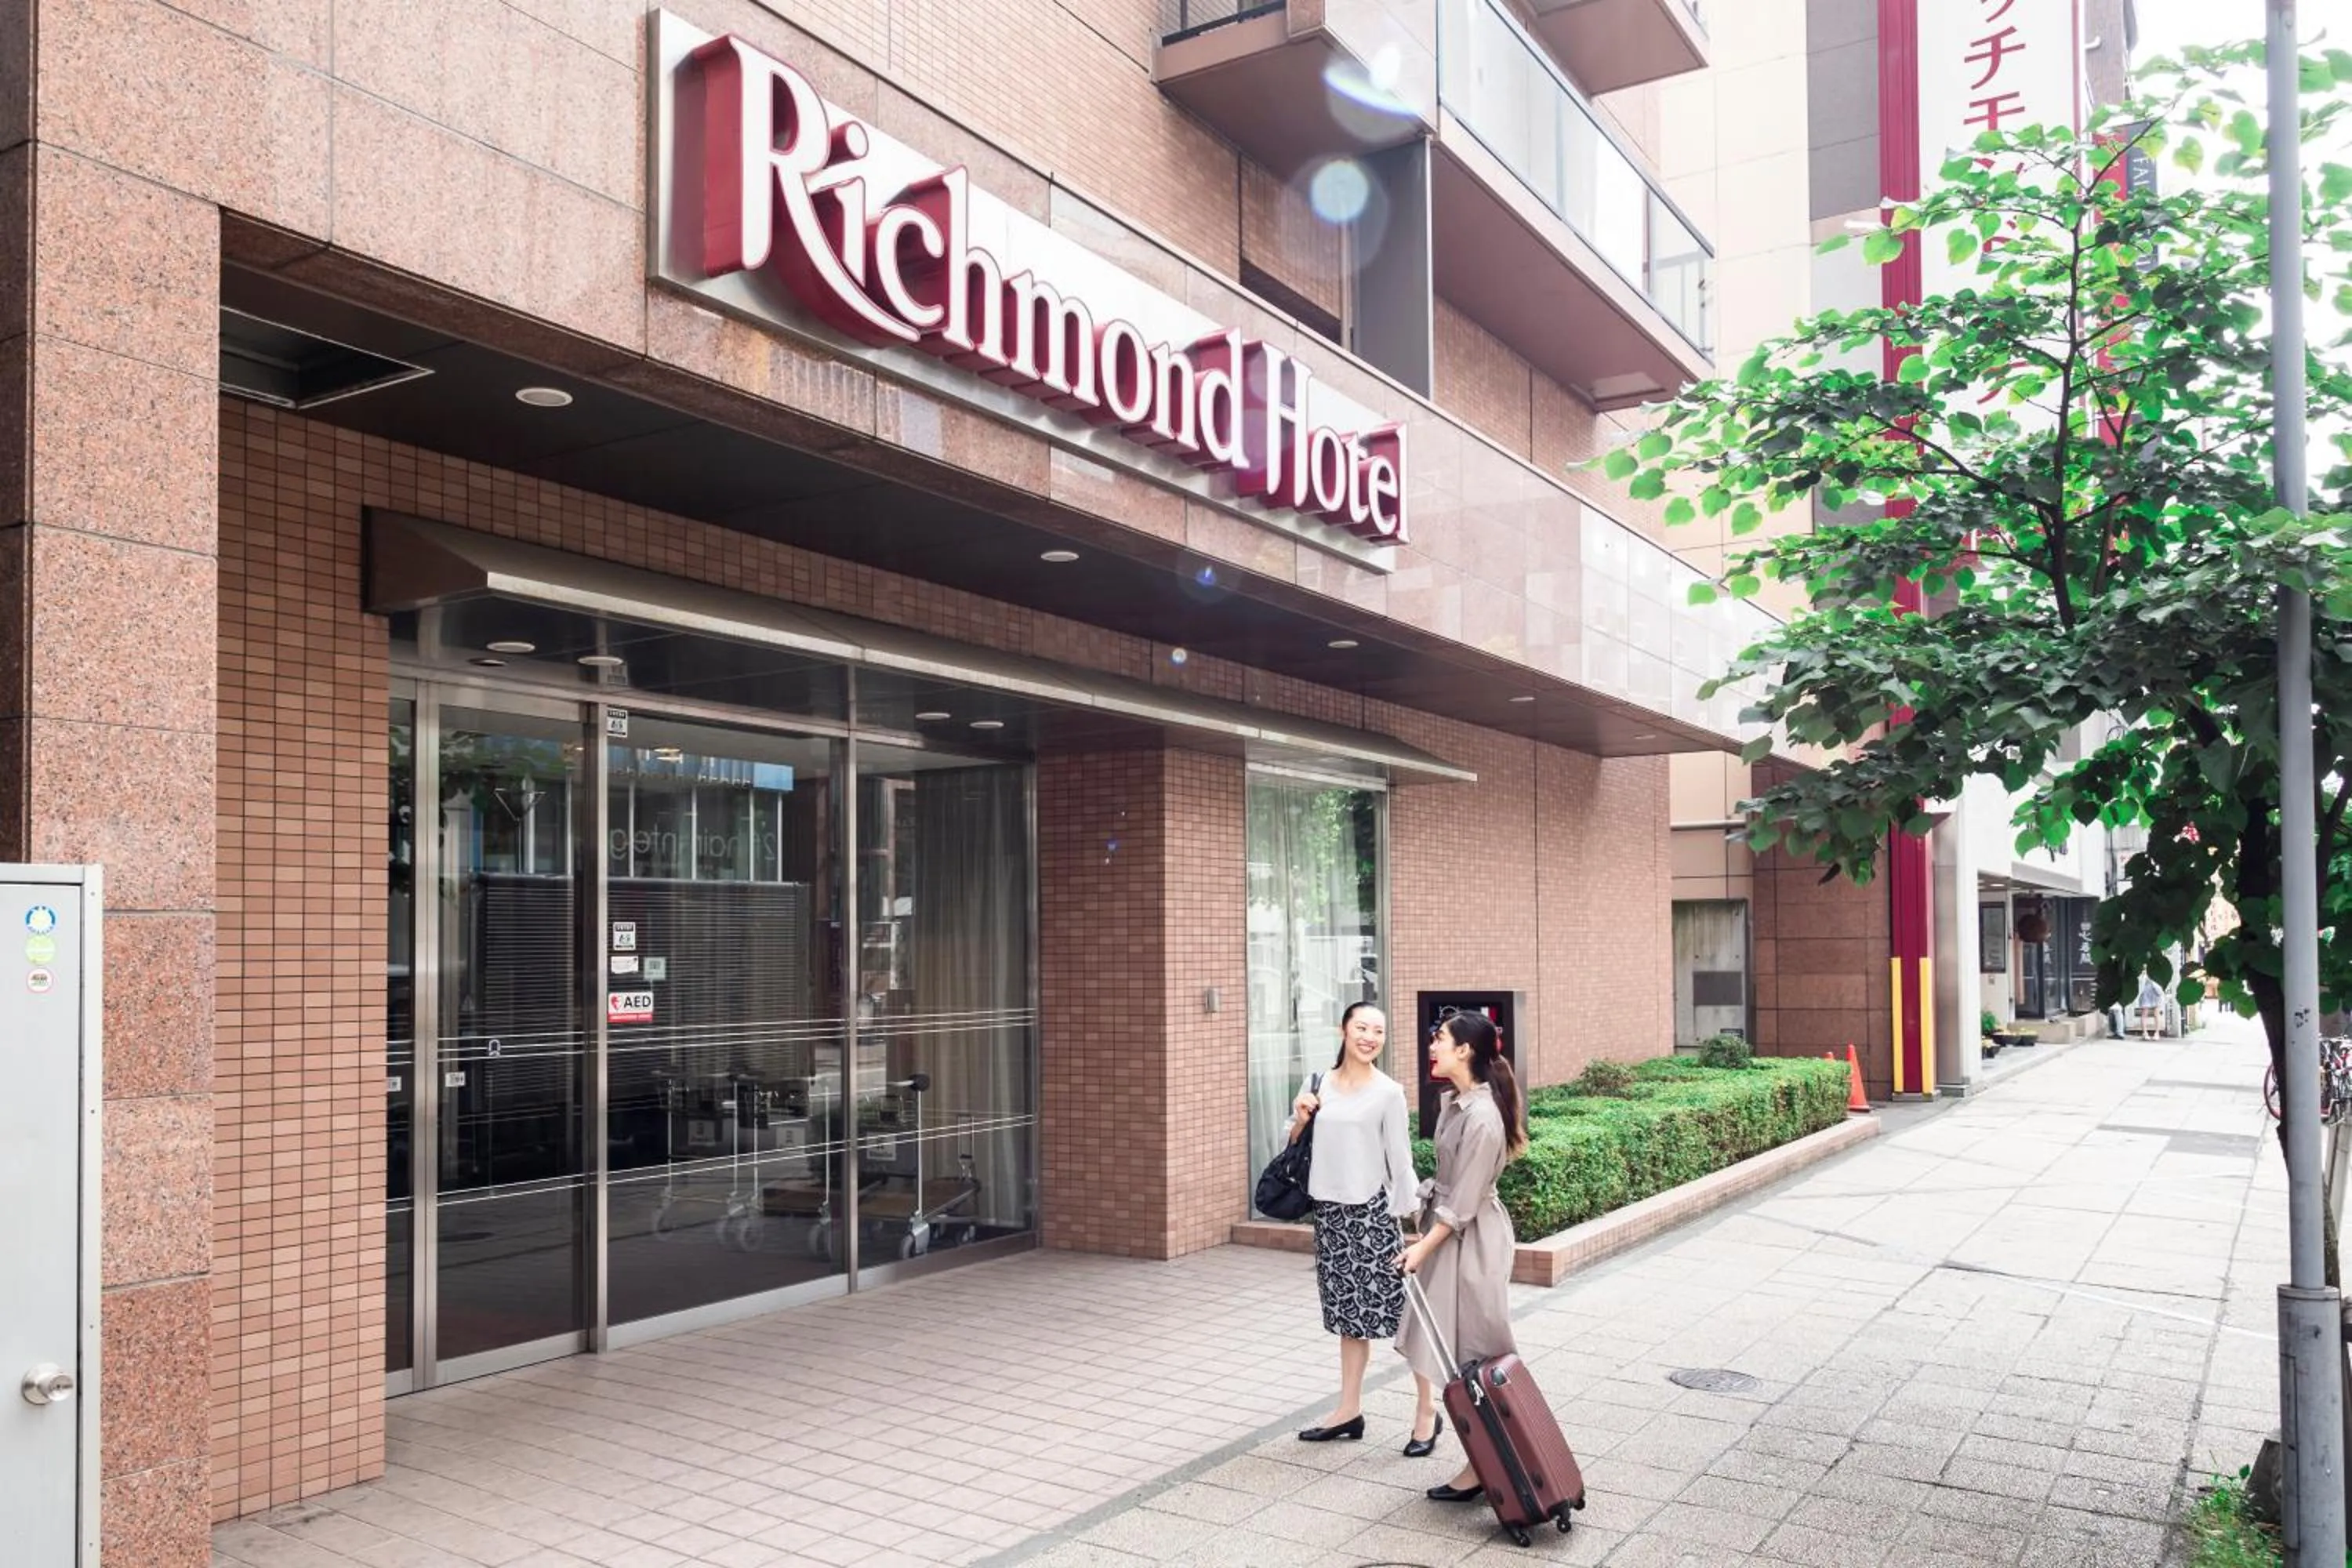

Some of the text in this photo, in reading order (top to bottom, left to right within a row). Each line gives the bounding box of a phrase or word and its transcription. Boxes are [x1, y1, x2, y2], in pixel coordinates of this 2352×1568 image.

[695, 34, 1410, 546] Richmond Hotel
[623, 995, 652, 1008] AED
